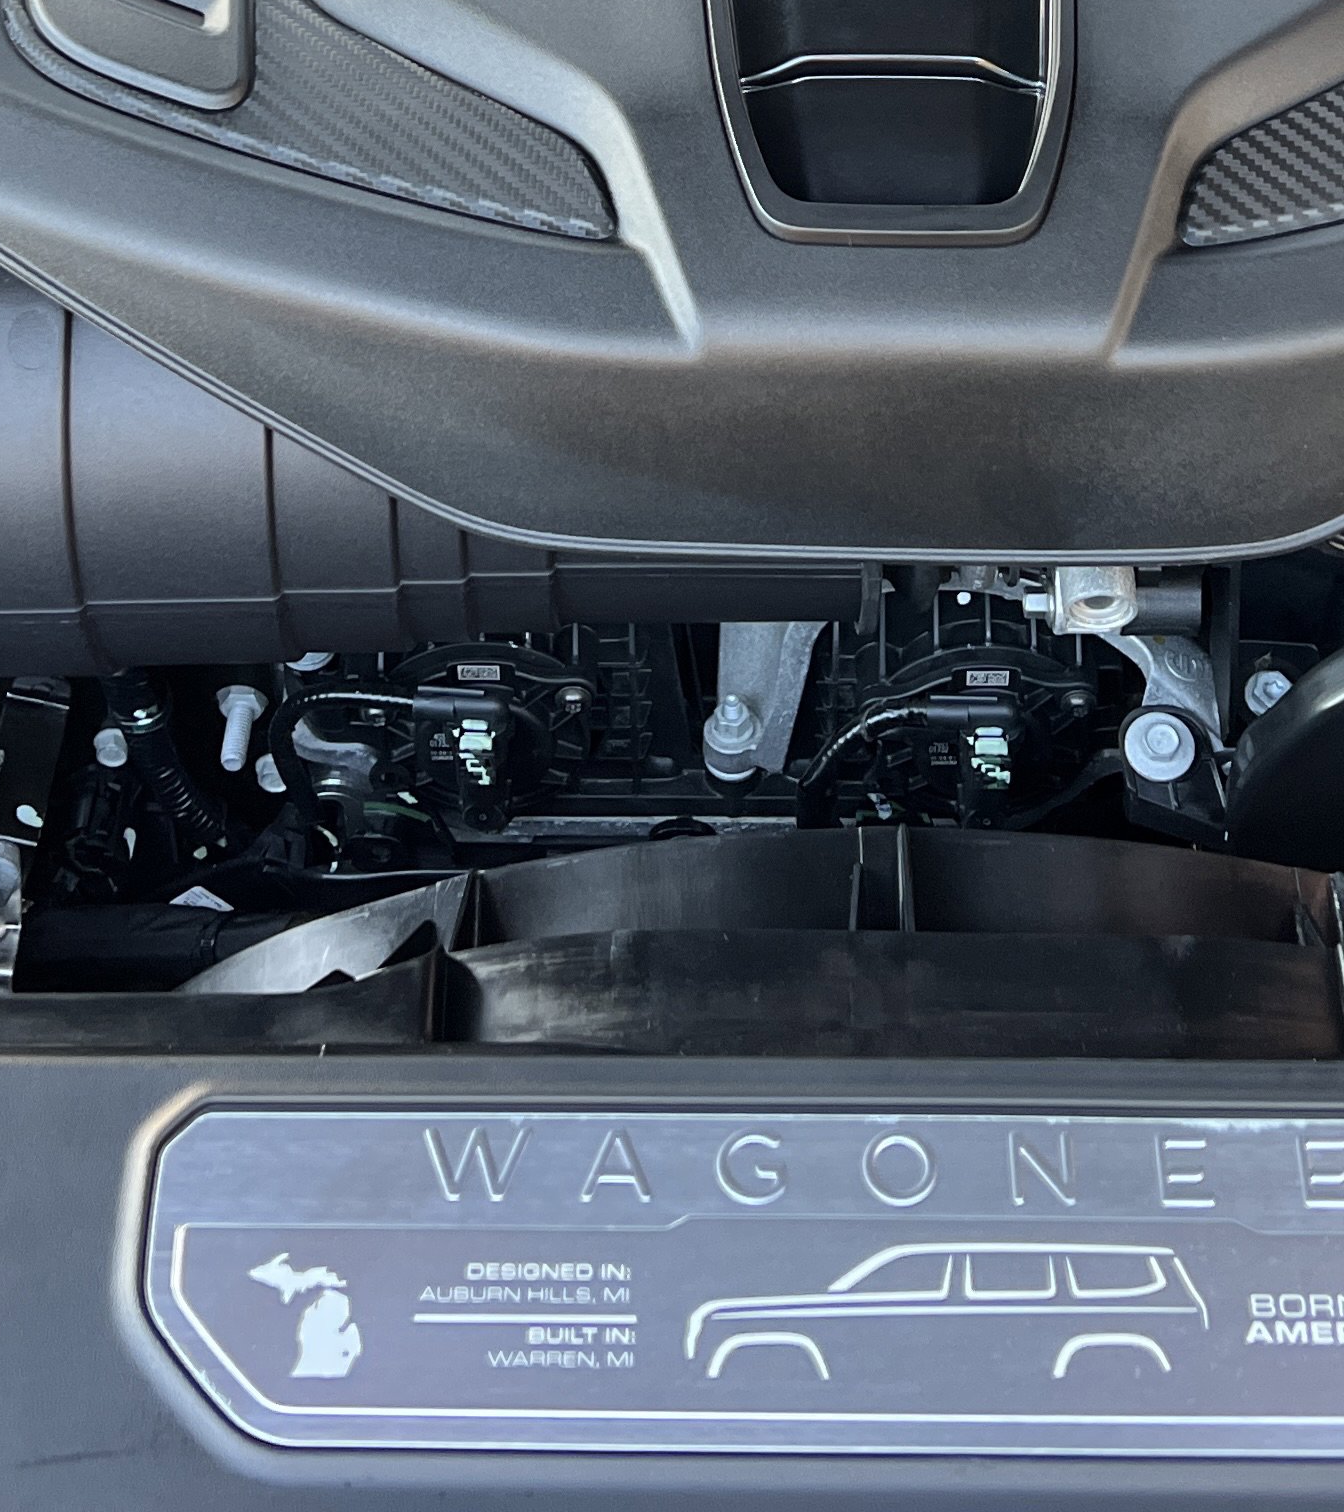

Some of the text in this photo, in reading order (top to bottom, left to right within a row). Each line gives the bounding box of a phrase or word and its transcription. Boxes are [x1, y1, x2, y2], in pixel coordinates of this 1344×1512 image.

[466, 1262, 632, 1281] DESIGNED IN:
[419, 1286, 630, 1304] AUBURN HILLS, MI
[527, 1326, 637, 1345] BUILT IN:
[487, 1350, 634, 1368] WARREN, MI
